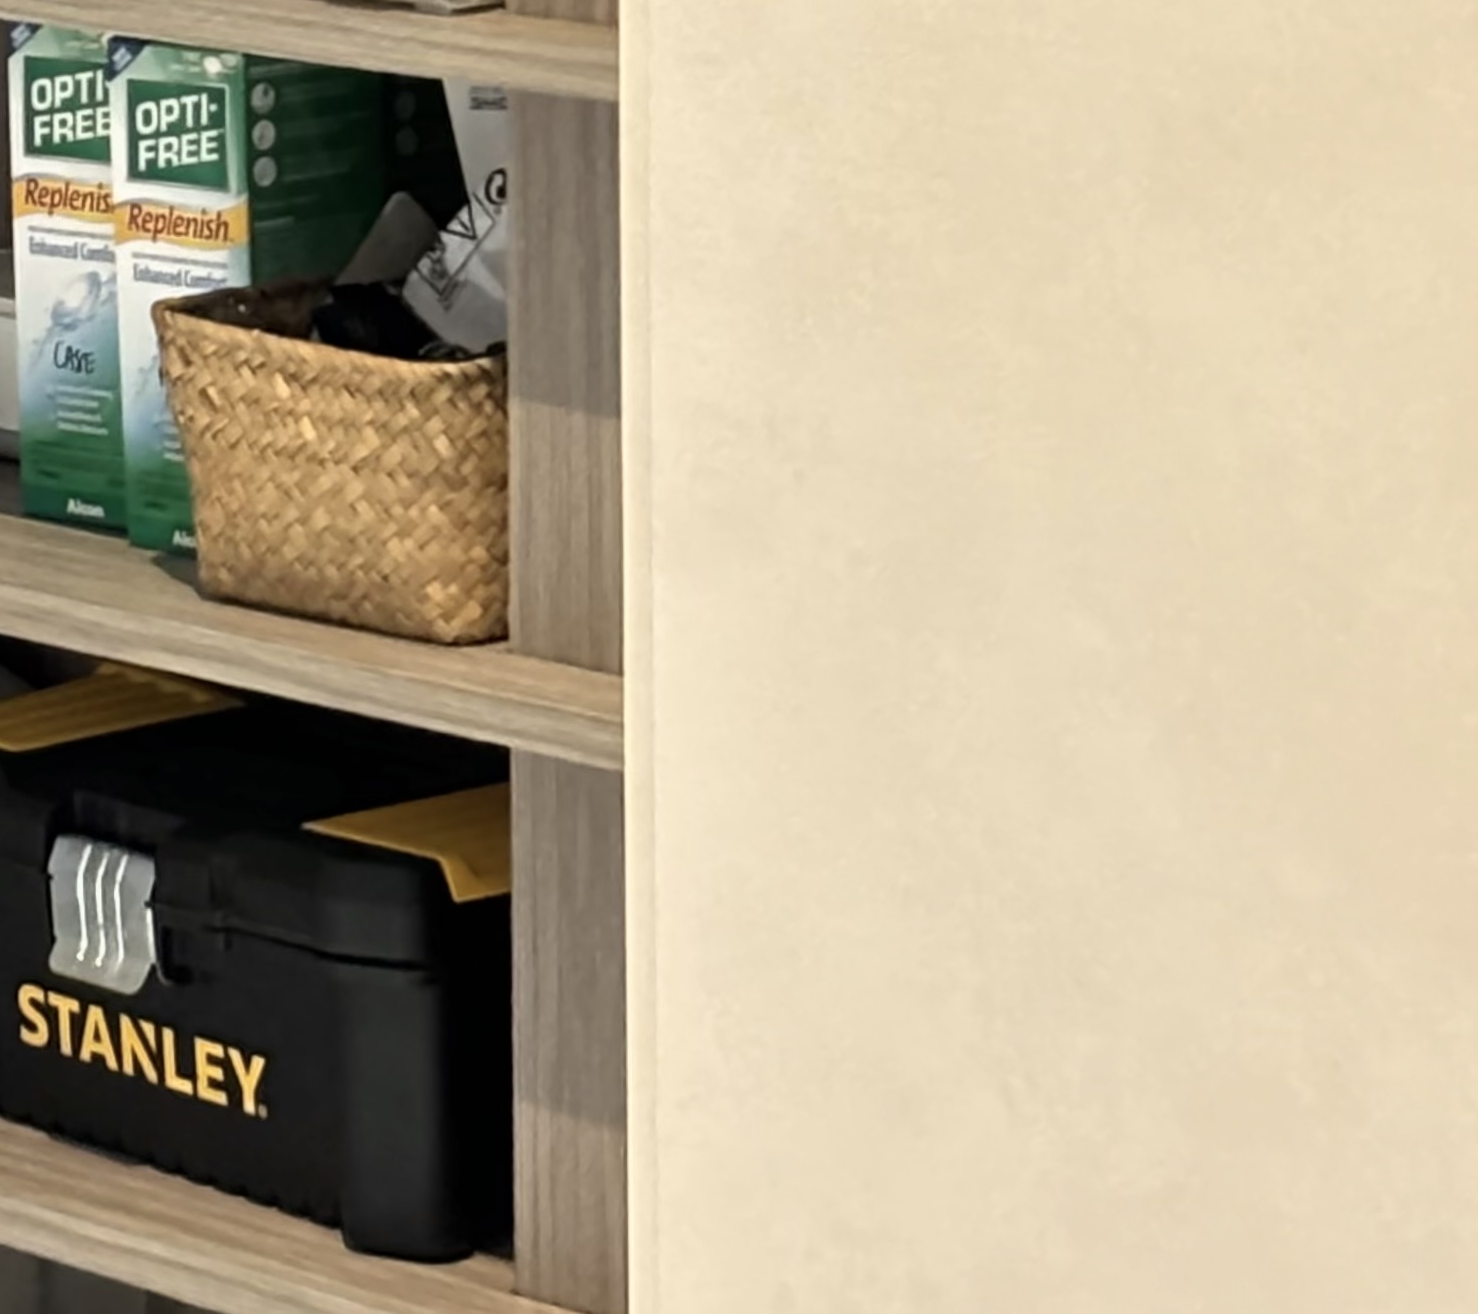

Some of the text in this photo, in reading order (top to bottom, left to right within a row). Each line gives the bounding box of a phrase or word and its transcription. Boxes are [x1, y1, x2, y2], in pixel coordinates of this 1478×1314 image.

[30, 69, 105, 111] OPTI
[33, 104, 111, 148] FREE
[135, 93, 219, 135] OPTI-
[137, 130, 220, 172] FREE
[24, 178, 112, 215] Replenis
[127, 202, 231, 243] Replenish
[17, 983, 266, 1117] STANLEY
